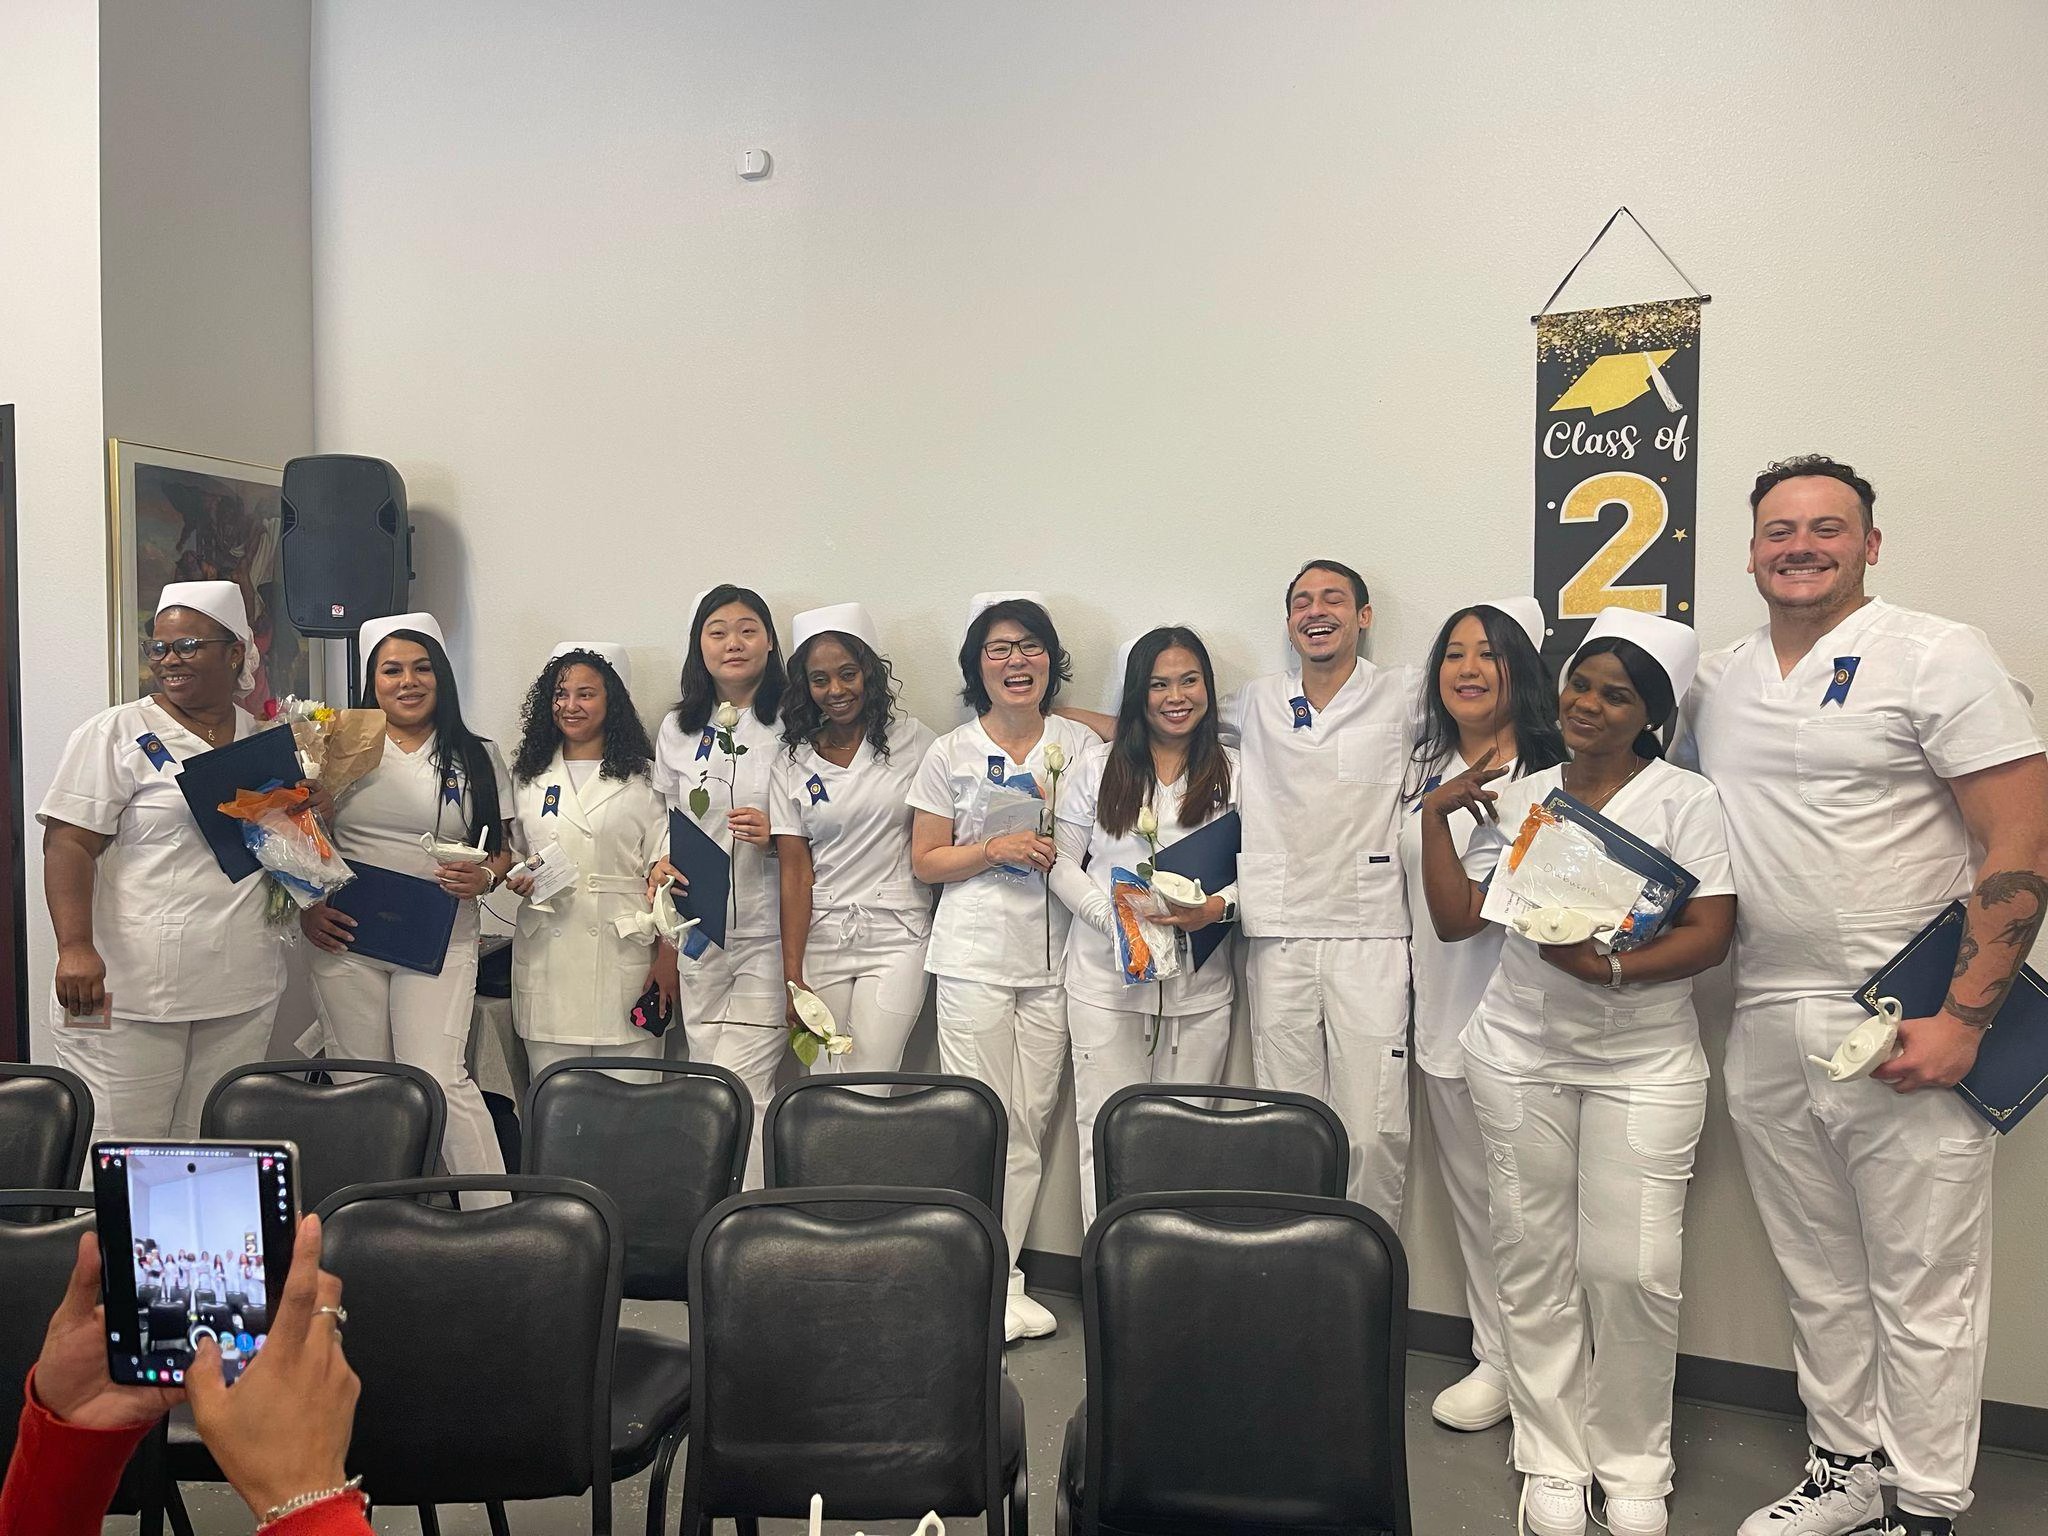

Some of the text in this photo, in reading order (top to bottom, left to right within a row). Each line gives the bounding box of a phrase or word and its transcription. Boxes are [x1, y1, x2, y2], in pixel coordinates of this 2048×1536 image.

[1543, 414, 1690, 462] Class of
[1558, 471, 1669, 619] 2
